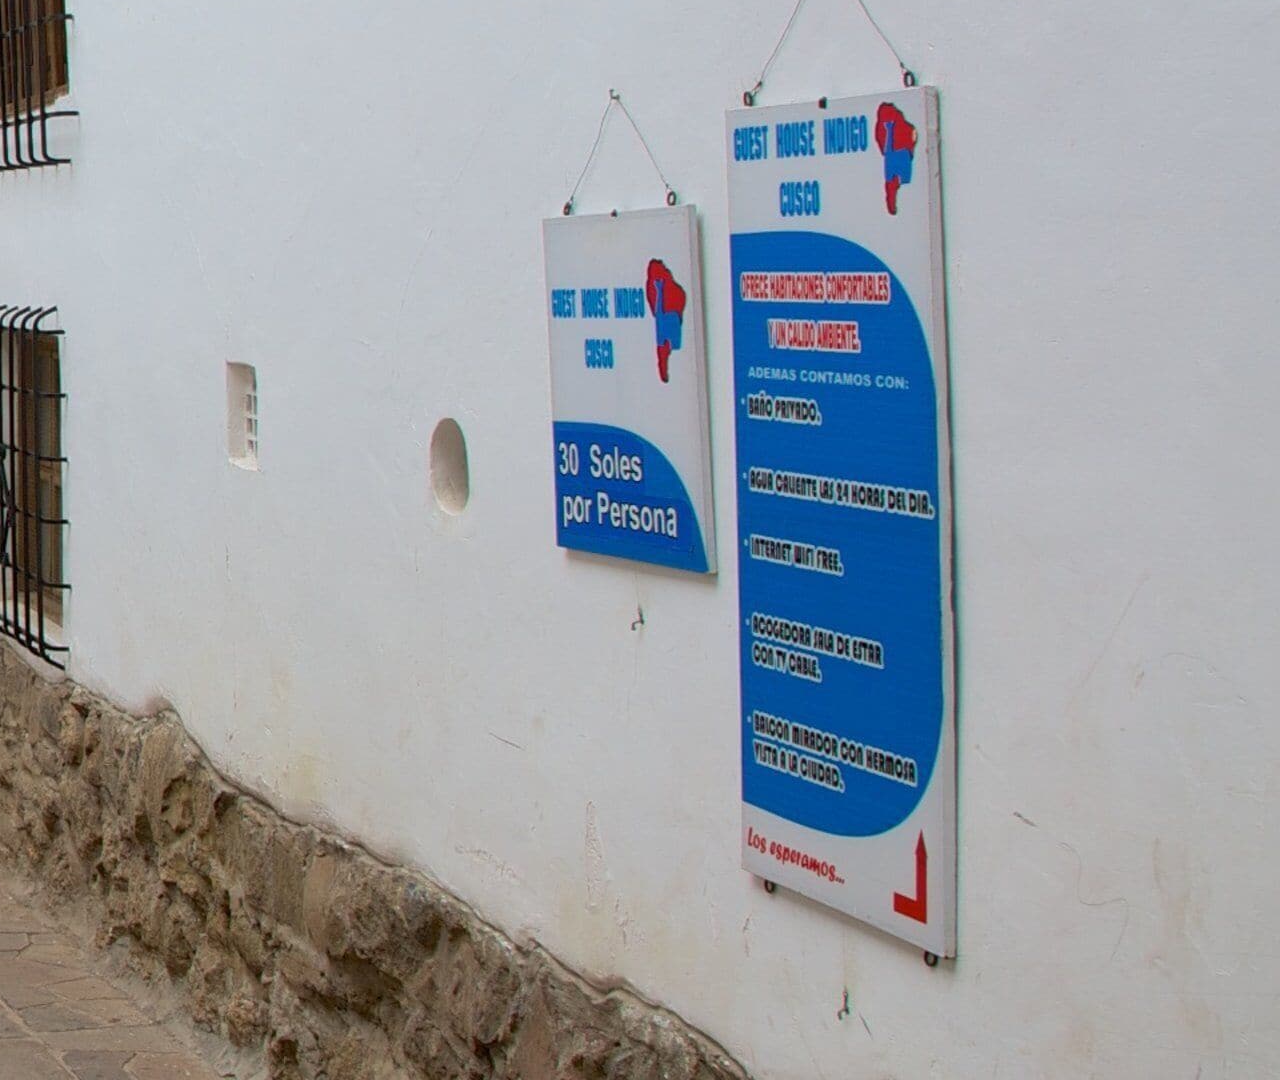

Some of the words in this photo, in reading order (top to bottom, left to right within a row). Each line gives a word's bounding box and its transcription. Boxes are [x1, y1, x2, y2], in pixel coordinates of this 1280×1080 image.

[733, 125, 768, 161] GUEST
[776, 120, 815, 158] HOUSE
[823, 115, 868, 155] INDIGO
[779, 180, 821, 217] CUSCO
[552, 288, 576, 318] GUEST
[581, 288, 609, 318] HOUSE
[614, 287, 645, 319] INDIGO
[741, 273, 769, 300] OFRECE
[770, 273, 825, 301] HABITACIONES
[826, 273, 889, 302] CONFORTABLES
[767, 320, 775, 348] Y
[776, 321, 787, 348] UN
[787, 320, 816, 350] CALIDO
[585, 339, 614, 369] CUSCO
[747, 366, 797, 382] ADEMAS
[799, 370, 871, 387] CONTAMOS
[875, 375, 910, 390] CON:
[749, 391, 773, 418] BAÑO
[774, 399, 821, 423] PRIVADO.
[558, 442, 579, 476] 30
[590, 444, 642, 482] Soles
[750, 469, 773, 493] AGUA
[775, 473, 817, 499] CALIENTE
[819, 480, 834, 501] LAS
[836, 482, 850, 504] 24
[851, 483, 885, 510] HORAS
[887, 488, 907, 512] DEL
[563, 493, 592, 528] por
[597, 491, 678, 538] Persona
[750, 536, 792, 563] INTERNET
[815, 548, 844, 574] FREE.
[752, 613, 811, 647] ACOGEDORA
[813, 628, 834, 652] SALA
[836, 634, 851, 658] DE
[852, 639, 883, 667] ESTAR
[752, 643, 774, 666] CON
[775, 648, 788, 671] TV
[753, 711, 790, 741] BALCON
[791, 723, 839, 757] MIRADOR
[839, 739, 864, 766] CON
[865, 747, 917, 786] HERMOSA
[753, 741, 778, 766] VISTA
[779, 748, 787, 770] A
[788, 751, 798, 774] LA
[747, 826, 767, 854] Los
[769, 840, 845, 885] esperamos...
